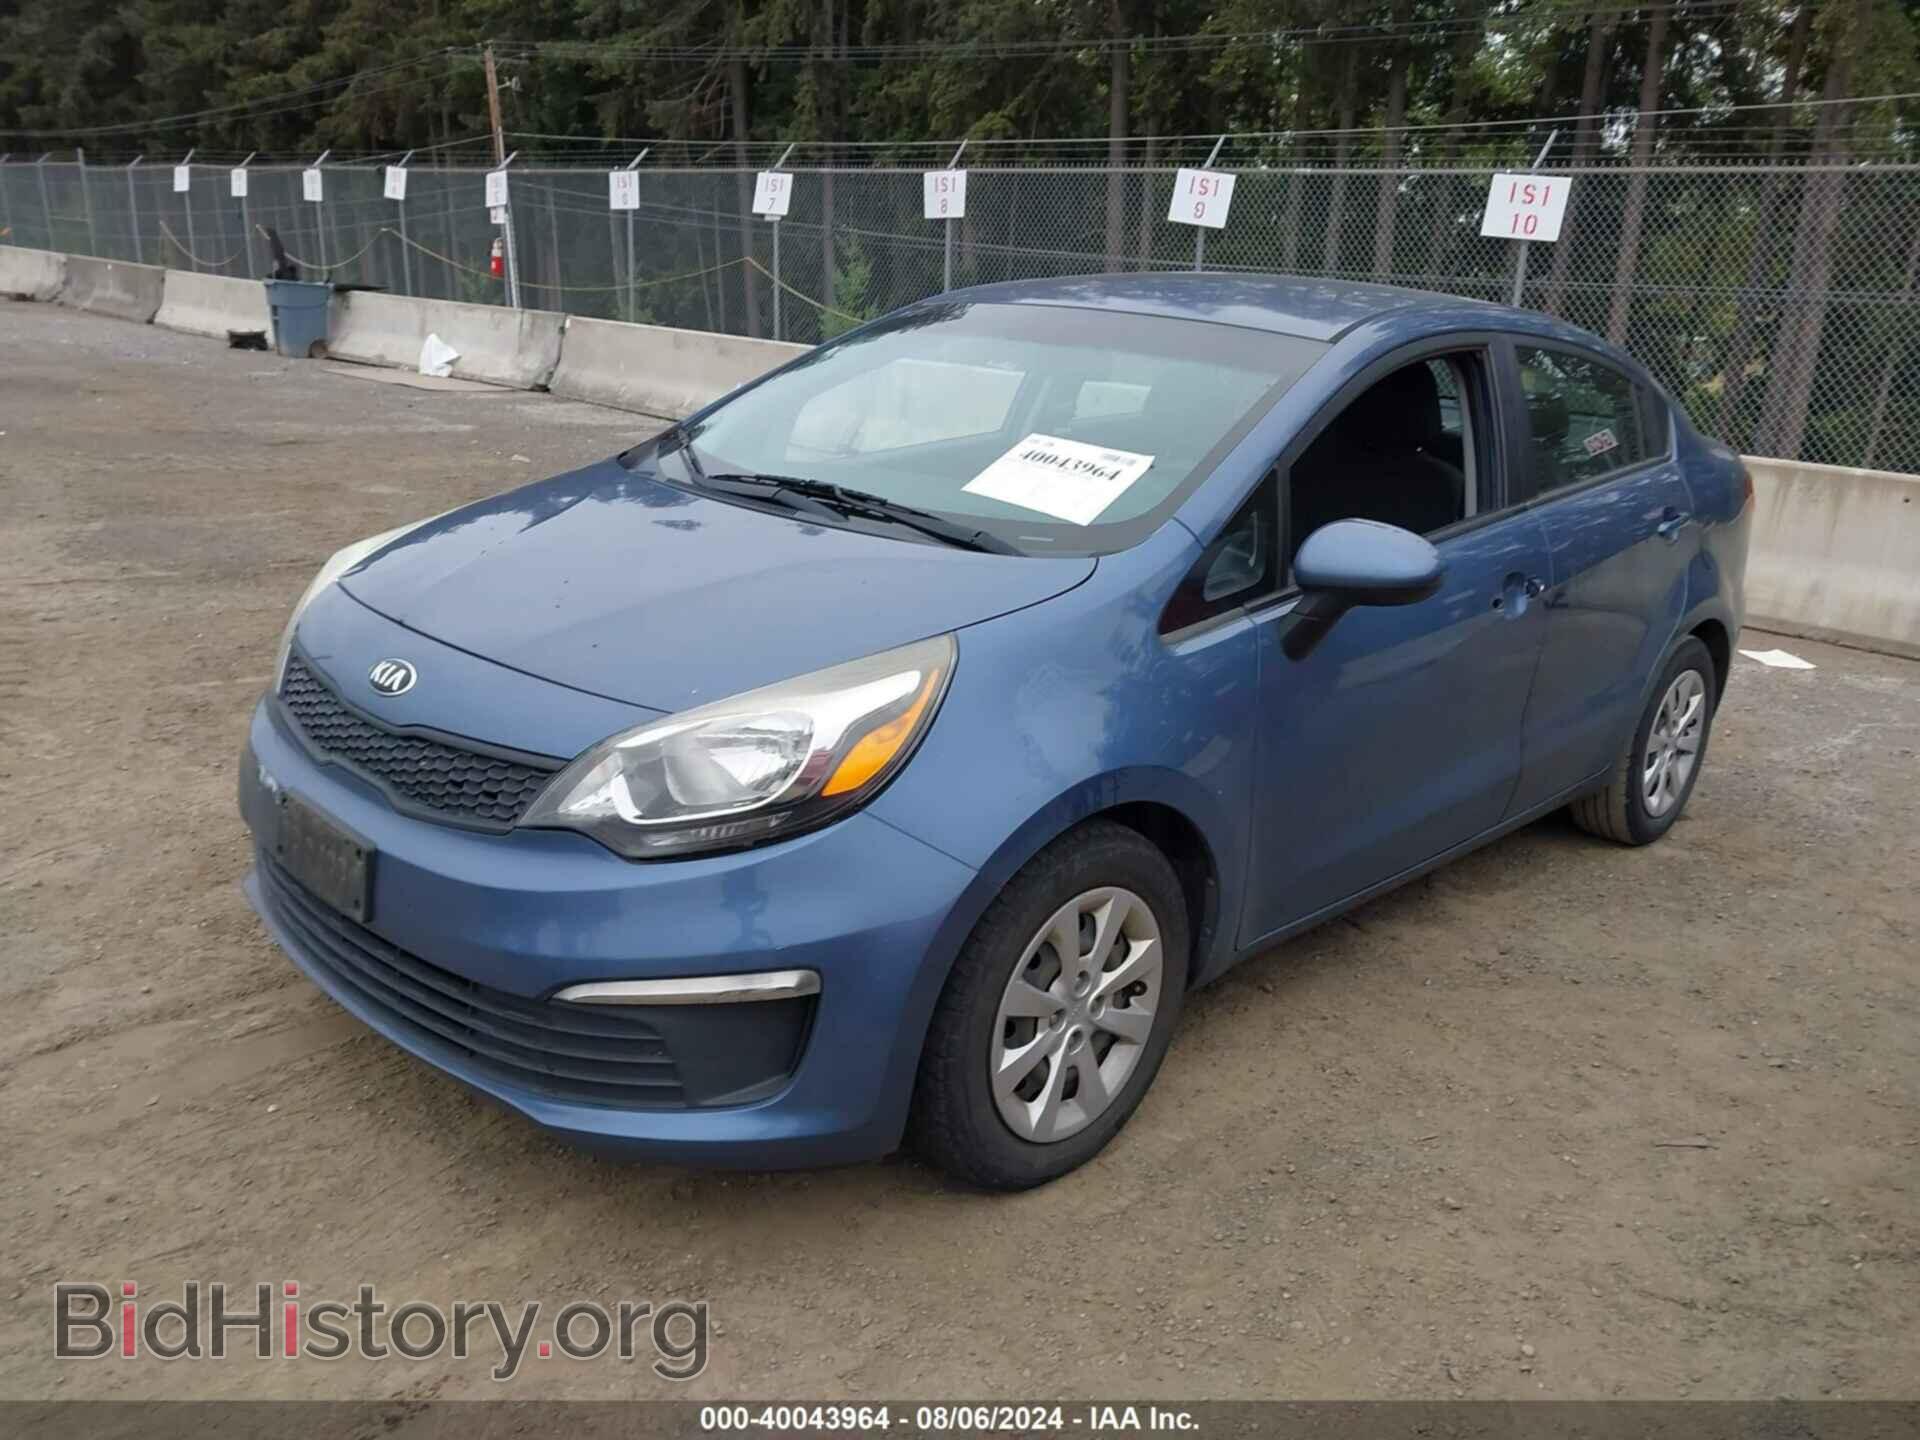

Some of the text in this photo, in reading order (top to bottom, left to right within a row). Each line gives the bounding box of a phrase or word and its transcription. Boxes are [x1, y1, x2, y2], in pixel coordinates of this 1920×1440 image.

[766, 197, 777, 211] 7
[1193, 201, 1206, 219] 9
[1511, 213, 1539, 235] 10
[1020, 449, 1122, 481] 40043964
[369, 662, 408, 691] KIA
